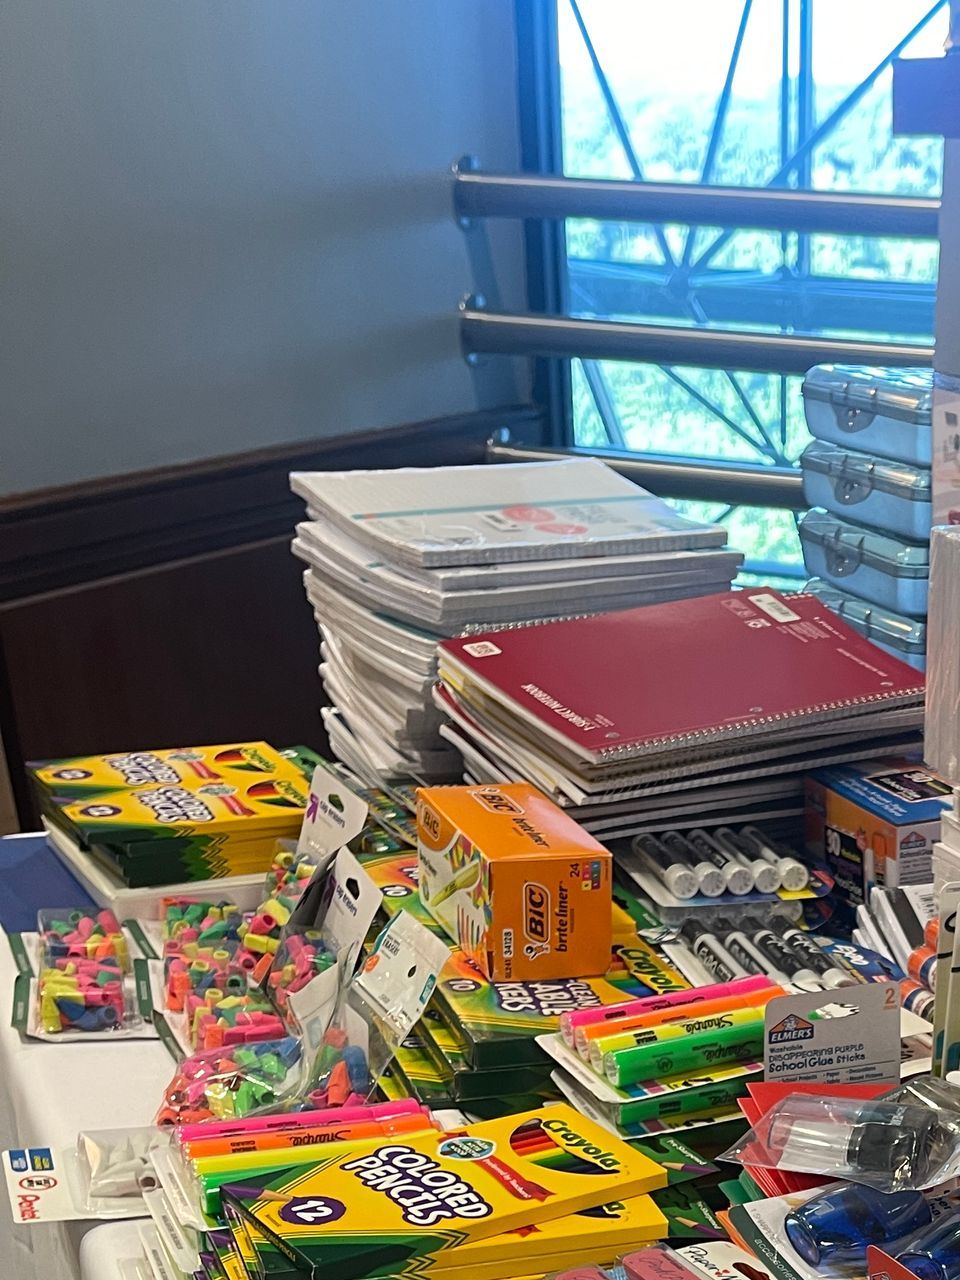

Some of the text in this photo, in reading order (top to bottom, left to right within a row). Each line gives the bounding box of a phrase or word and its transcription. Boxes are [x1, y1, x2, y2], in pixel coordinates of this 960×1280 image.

[570, 863, 580, 878] 24
[504, 931, 513, 956] 34128
[885, 988, 894, 1004] 2
[682, 1014, 733, 1034] Sharpie
[771, 1028, 812, 1042] ELMER'S
[769, 1054, 865, 1073] School Glue Sticks
[542, 1120, 622, 1168] Crayola
[342, 1156, 452, 1225] PENCILS
[377, 1146, 489, 1218] COLORED
[291, 1200, 332, 1222] 12
[683, 1247, 718, 1274] Paper
